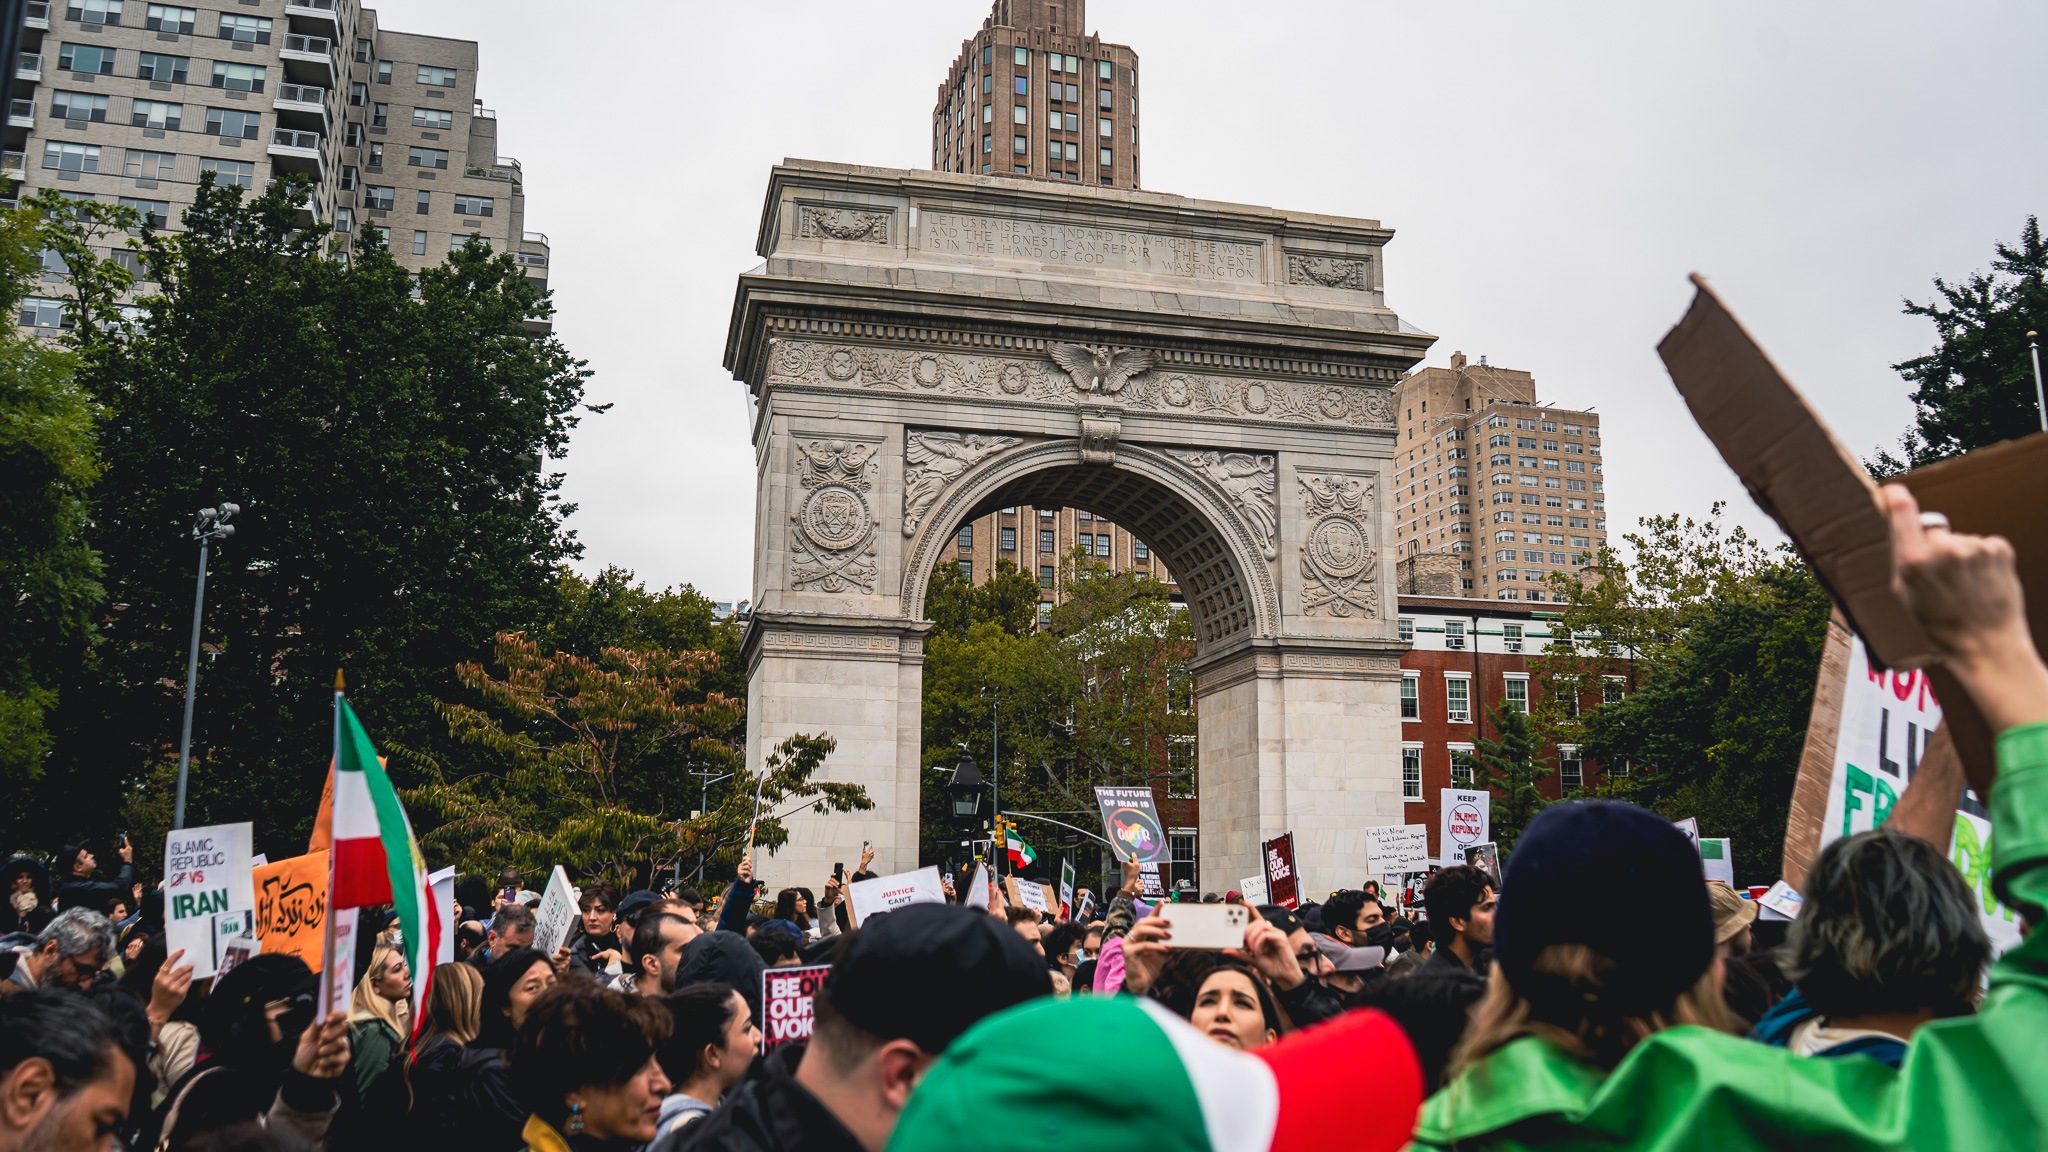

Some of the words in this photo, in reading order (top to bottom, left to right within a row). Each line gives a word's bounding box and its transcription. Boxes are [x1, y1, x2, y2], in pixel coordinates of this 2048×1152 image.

[930, 214, 957, 227] LET
[961, 217, 977, 228] US
[980, 219, 1020, 233] RAISE
[1025, 224, 1035, 235] A
[1040, 225, 1114, 242] STANDARD
[1118, 233, 1137, 245] TO
[1141, 234, 1186, 250] WHICH
[1192, 240, 1217, 253] THE
[1221, 244, 1253, 257] WISE
[929, 226, 958, 238] AND
[964, 229, 992, 242] THE
[1000, 232, 1058, 248] HONEST
[1066, 239, 1096, 252] CAN
[1103, 242, 1151, 258] REPAIR
[1173, 249, 1200, 263] THE
[1208, 253, 1254, 268] EVENT
[929, 237, 941, 249] IS
[946, 239, 960, 250] IN
[966, 241, 995, 254] THE
[1002, 245, 1043, 258] HAND
[1049, 249, 1068, 260] OF
[1074, 252, 1105, 264] GOD
[1162, 260, 1255, 279] WASHINGTON
[1096, 789, 1115, 797] THE
[1116, 790, 1151, 798] FUTURE
[1117, 800, 1138, 808] IRAN
[1454, 812, 1478, 822] ISLAMIC
[1389, 827, 1406, 835] Near
[1451, 824, 1480, 836] REPUBLIC
[170, 837, 214, 855] ISLAMIC
[170, 851, 226, 872] REPUBLIC
[1268, 848, 1279, 861] BE
[1269, 857, 1284, 872] OUR
[188, 870, 205, 885] VS
[1270, 865, 1291, 882] VOICE
[881, 886, 916, 899] JUSTICE
[888, 895, 912, 905] CAN'T
[172, 887, 229, 921] IRAN
[771, 977, 801, 999] BE
[769, 996, 814, 1020] OUR
[771, 1016, 814, 1040] VOIC
